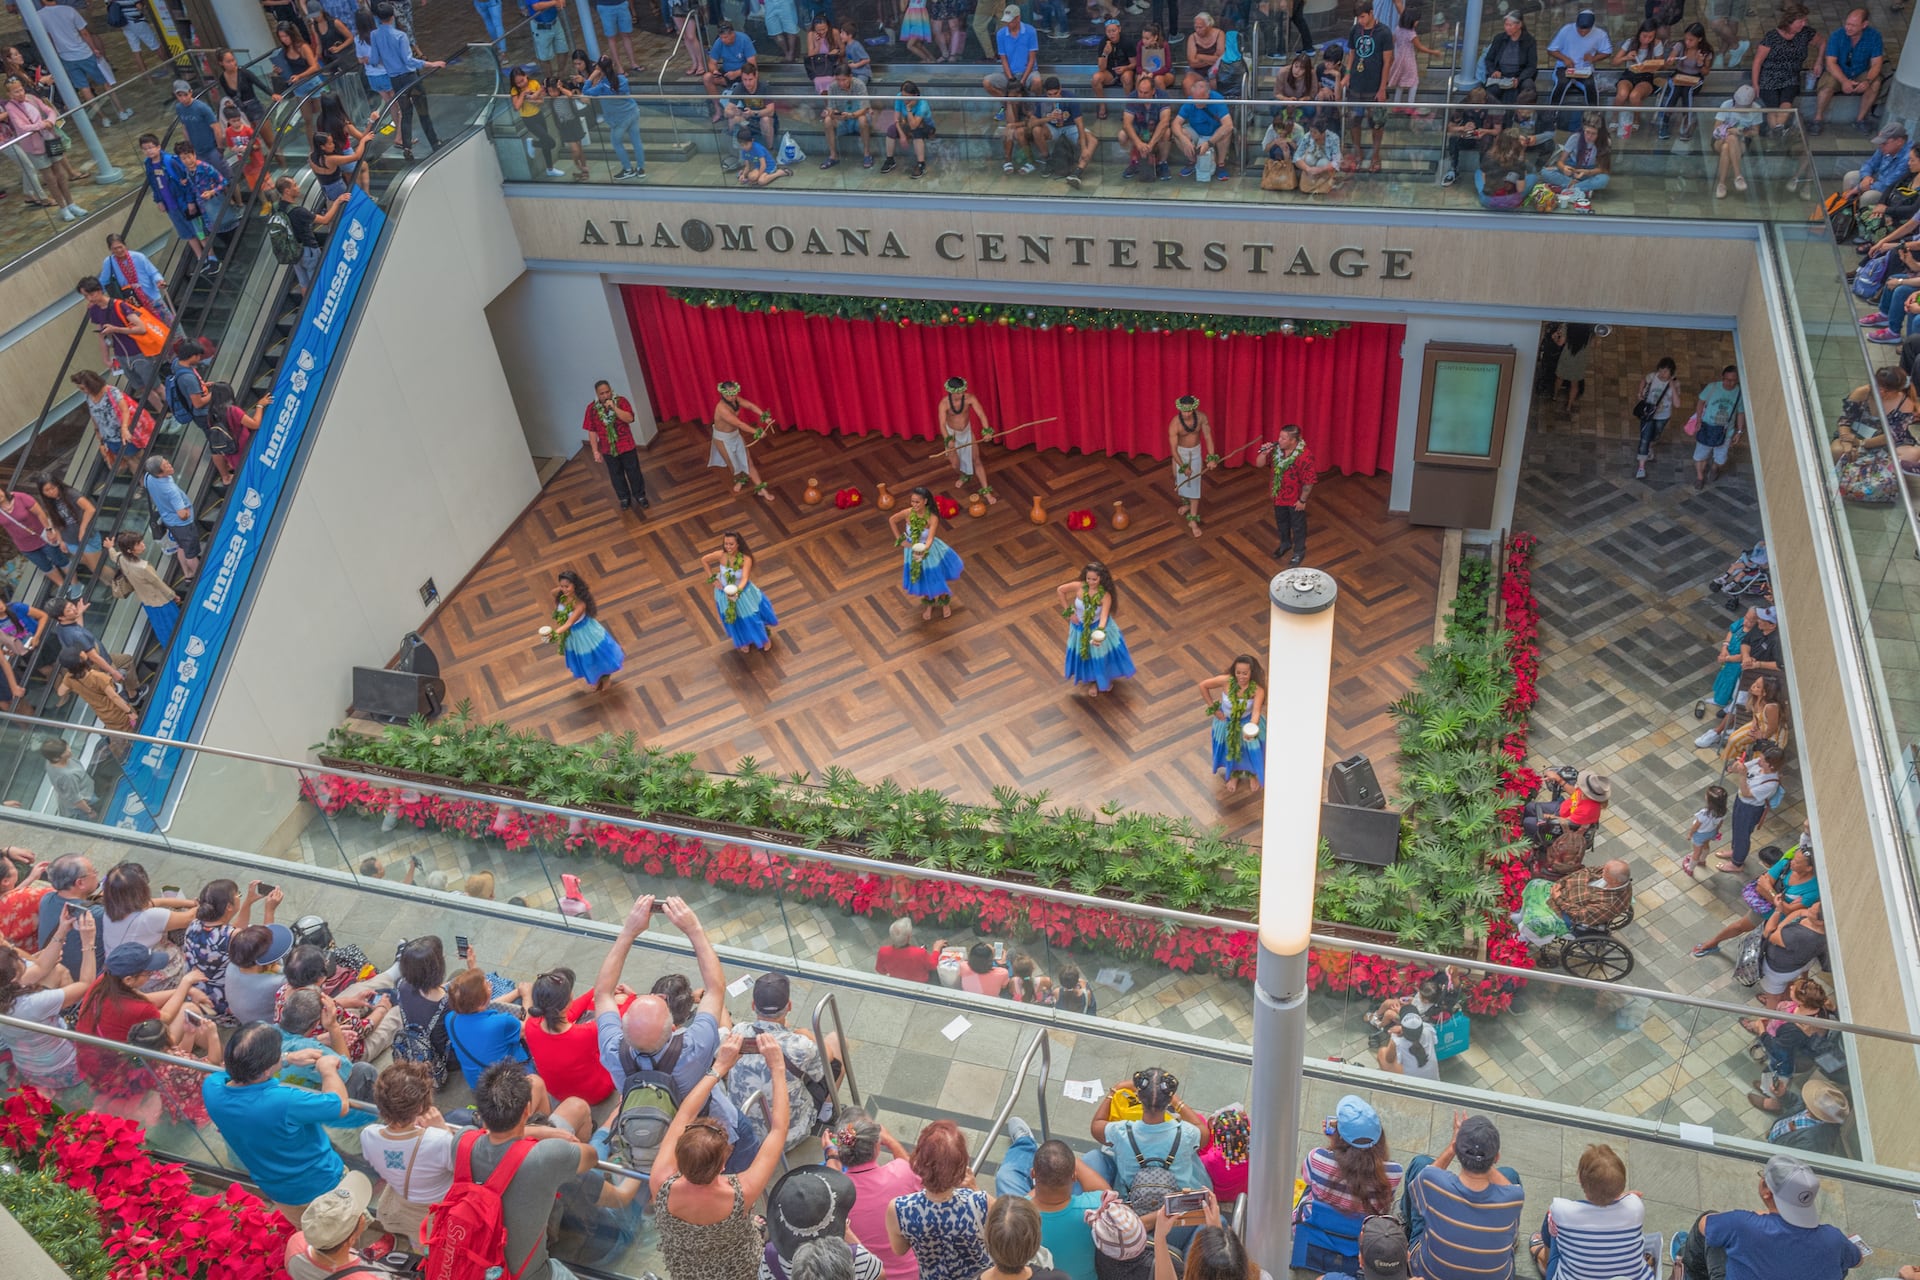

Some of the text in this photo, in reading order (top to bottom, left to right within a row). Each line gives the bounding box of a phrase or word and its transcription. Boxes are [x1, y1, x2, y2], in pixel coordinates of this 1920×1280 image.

[580, 218, 1414, 281] ALA MOANA CENTERSTAGE
[312, 260, 348, 330] hmsa
[259, 393, 299, 465] hmsa
[202, 534, 244, 611] hmsa
[141, 684, 185, 768] hmsa
